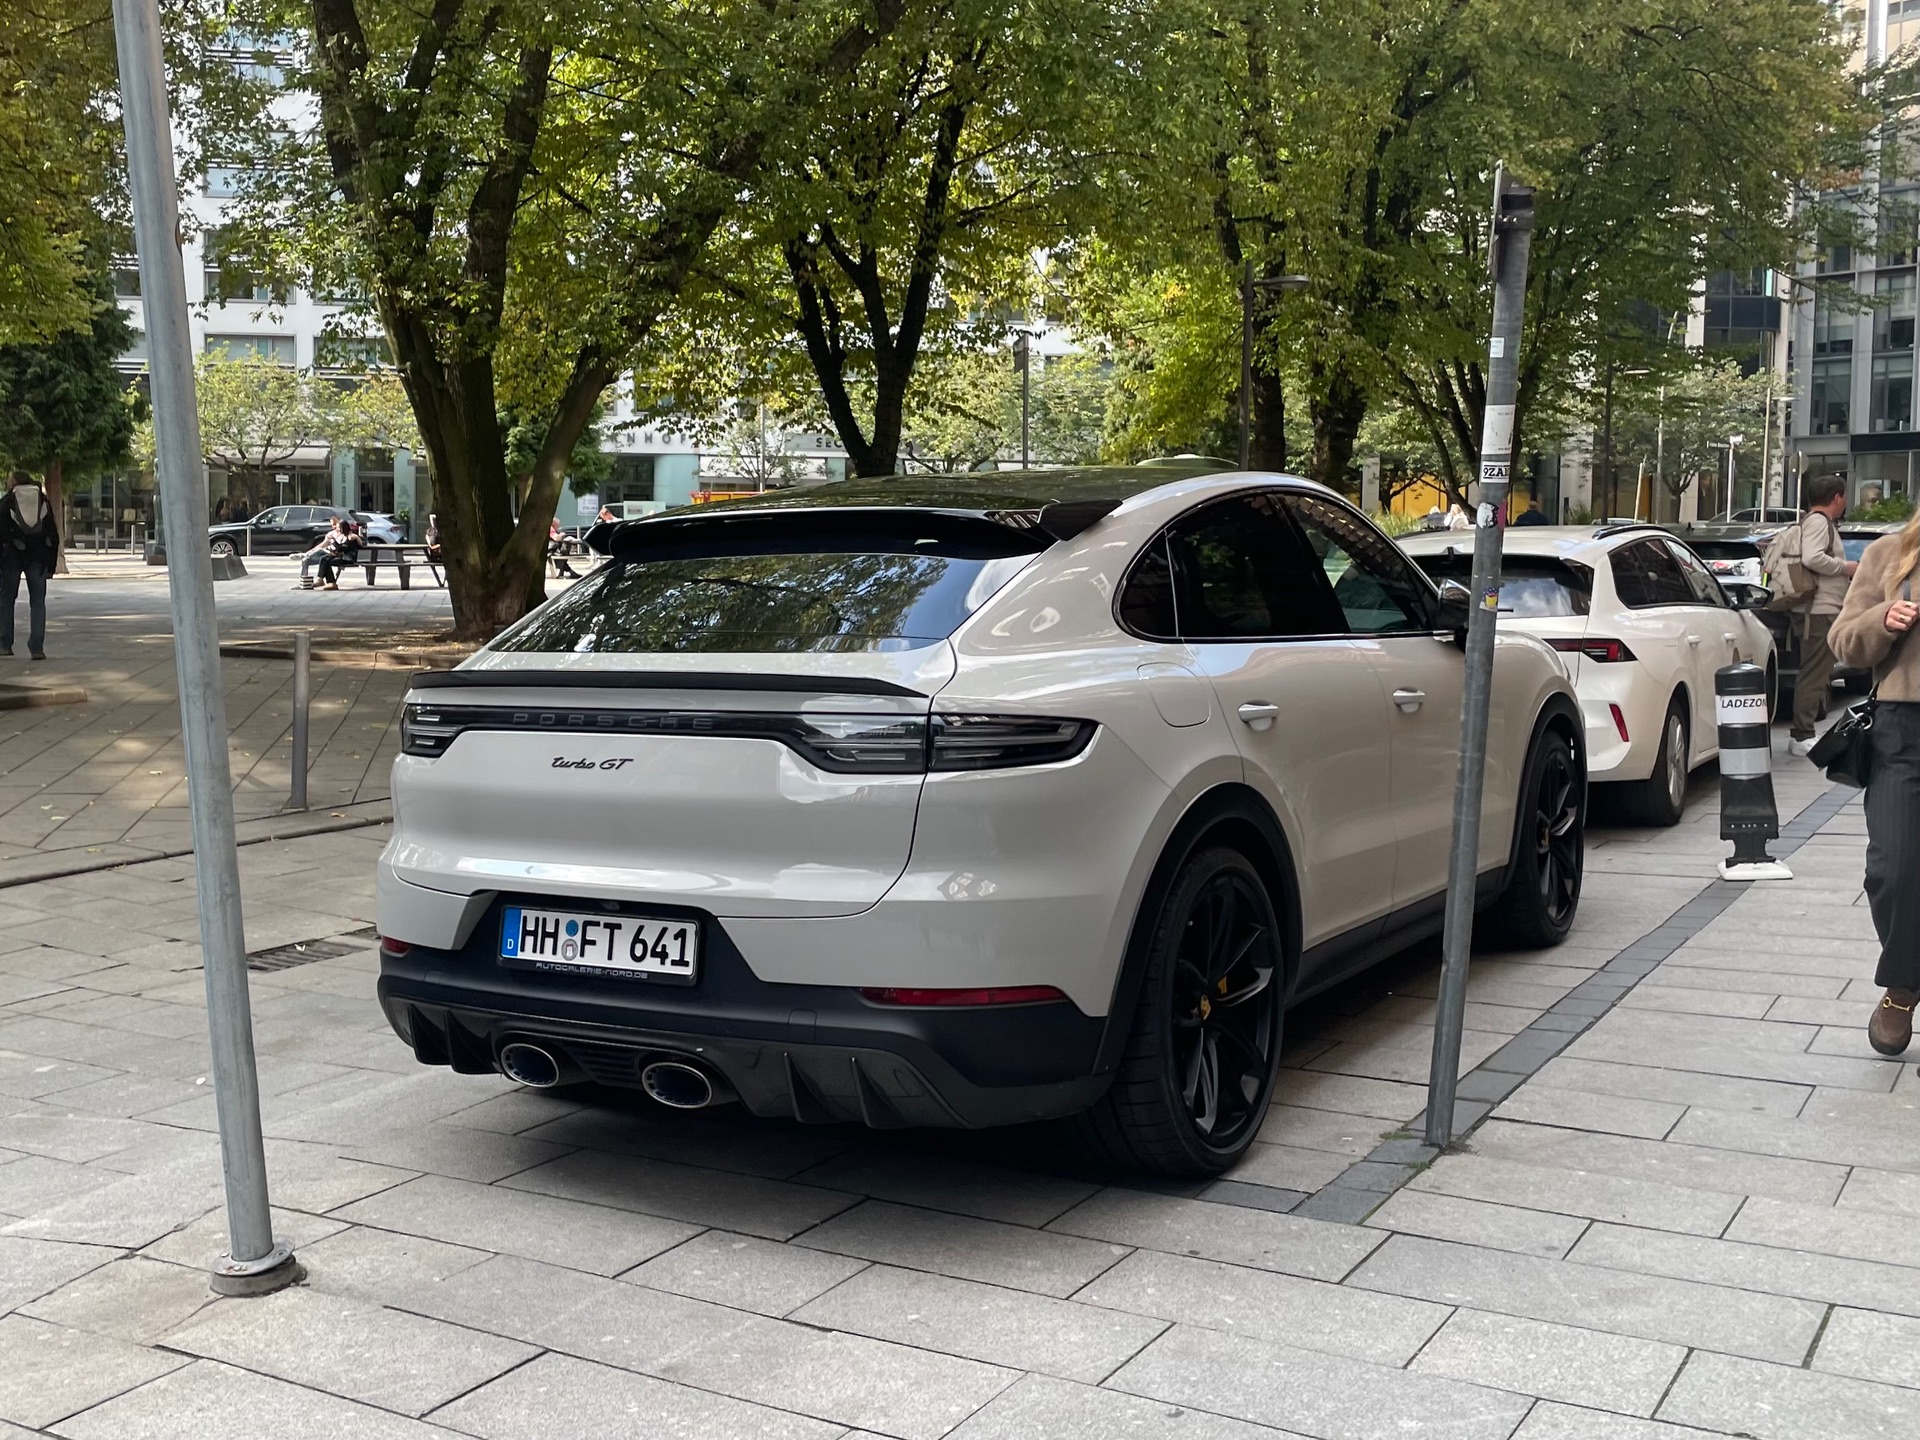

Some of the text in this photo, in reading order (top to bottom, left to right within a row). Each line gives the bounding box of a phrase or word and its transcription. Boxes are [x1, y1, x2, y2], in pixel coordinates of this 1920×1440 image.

[512, 713, 714, 729] PORSCHE
[551, 756, 634, 770] turbo GT
[506, 915, 690, 968] D HH FT 641
